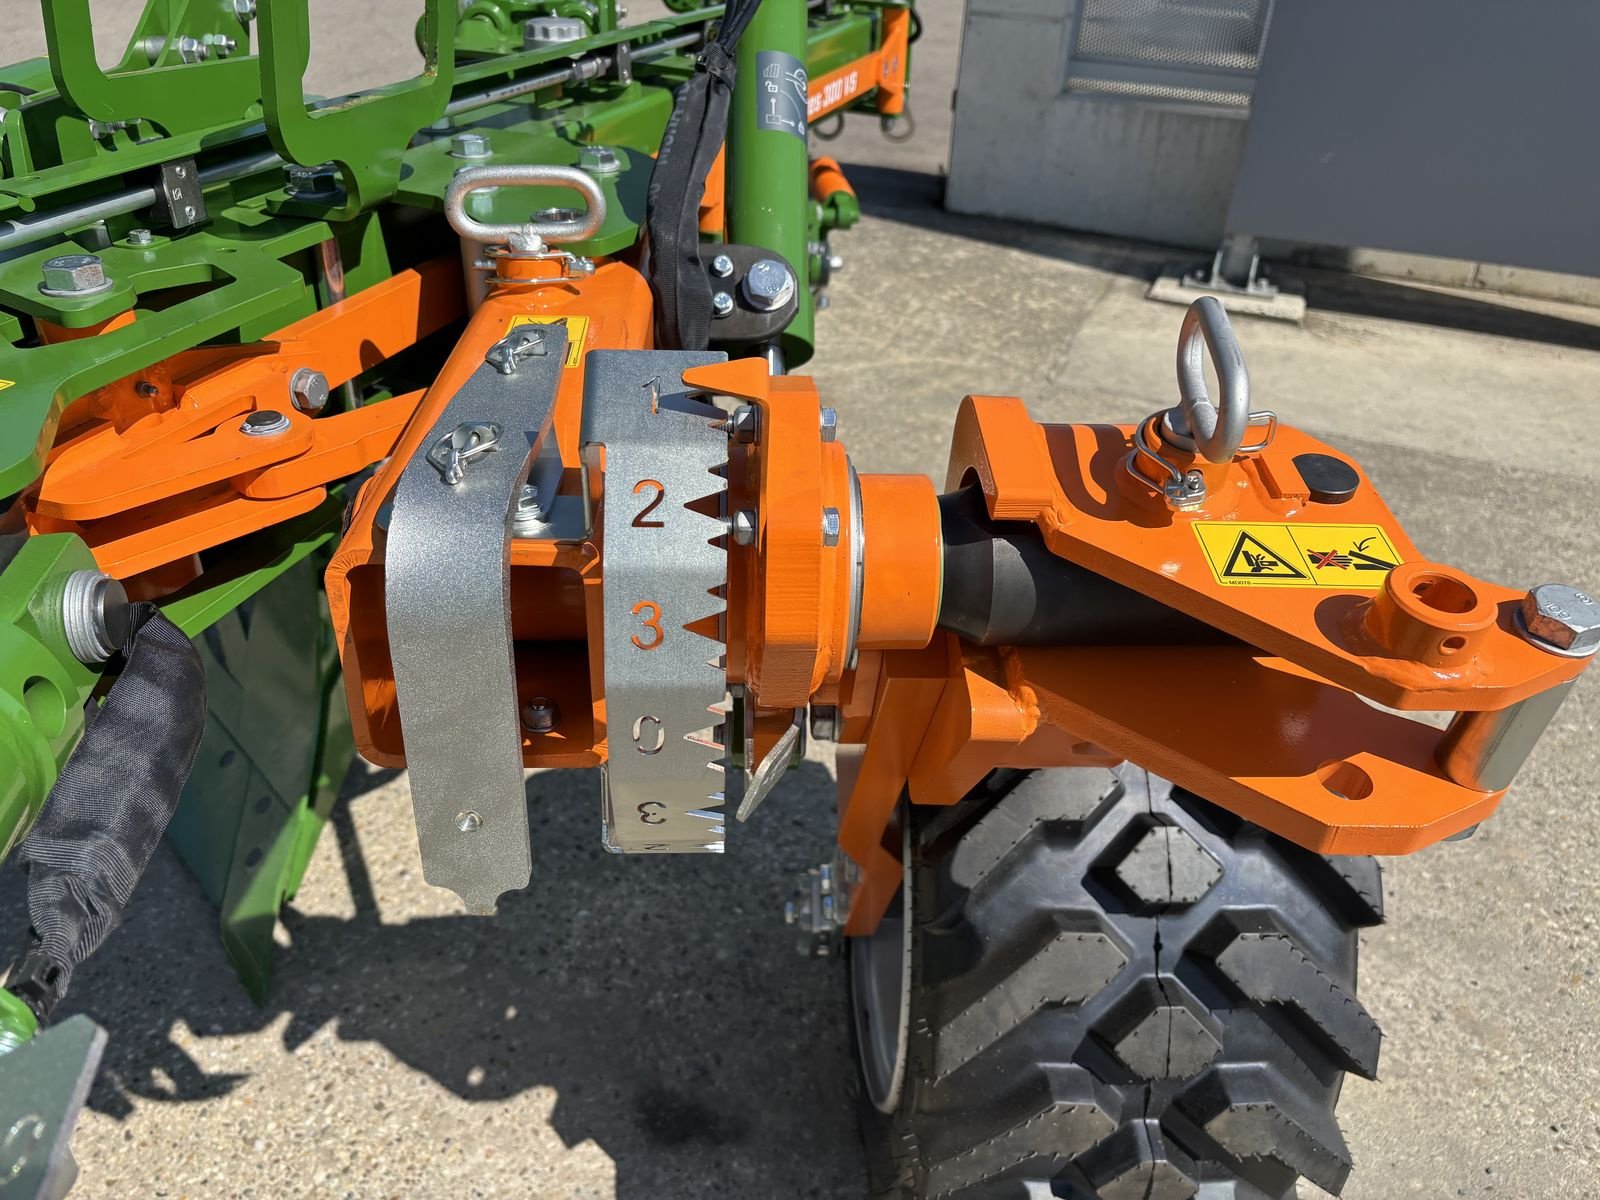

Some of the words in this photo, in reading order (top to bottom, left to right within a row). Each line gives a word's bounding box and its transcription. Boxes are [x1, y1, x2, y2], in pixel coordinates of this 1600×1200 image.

[642, 375, 661, 416] 1
[631, 478, 665, 528] 2
[630, 600, 665, 651] 3
[632, 715, 665, 756] 0
